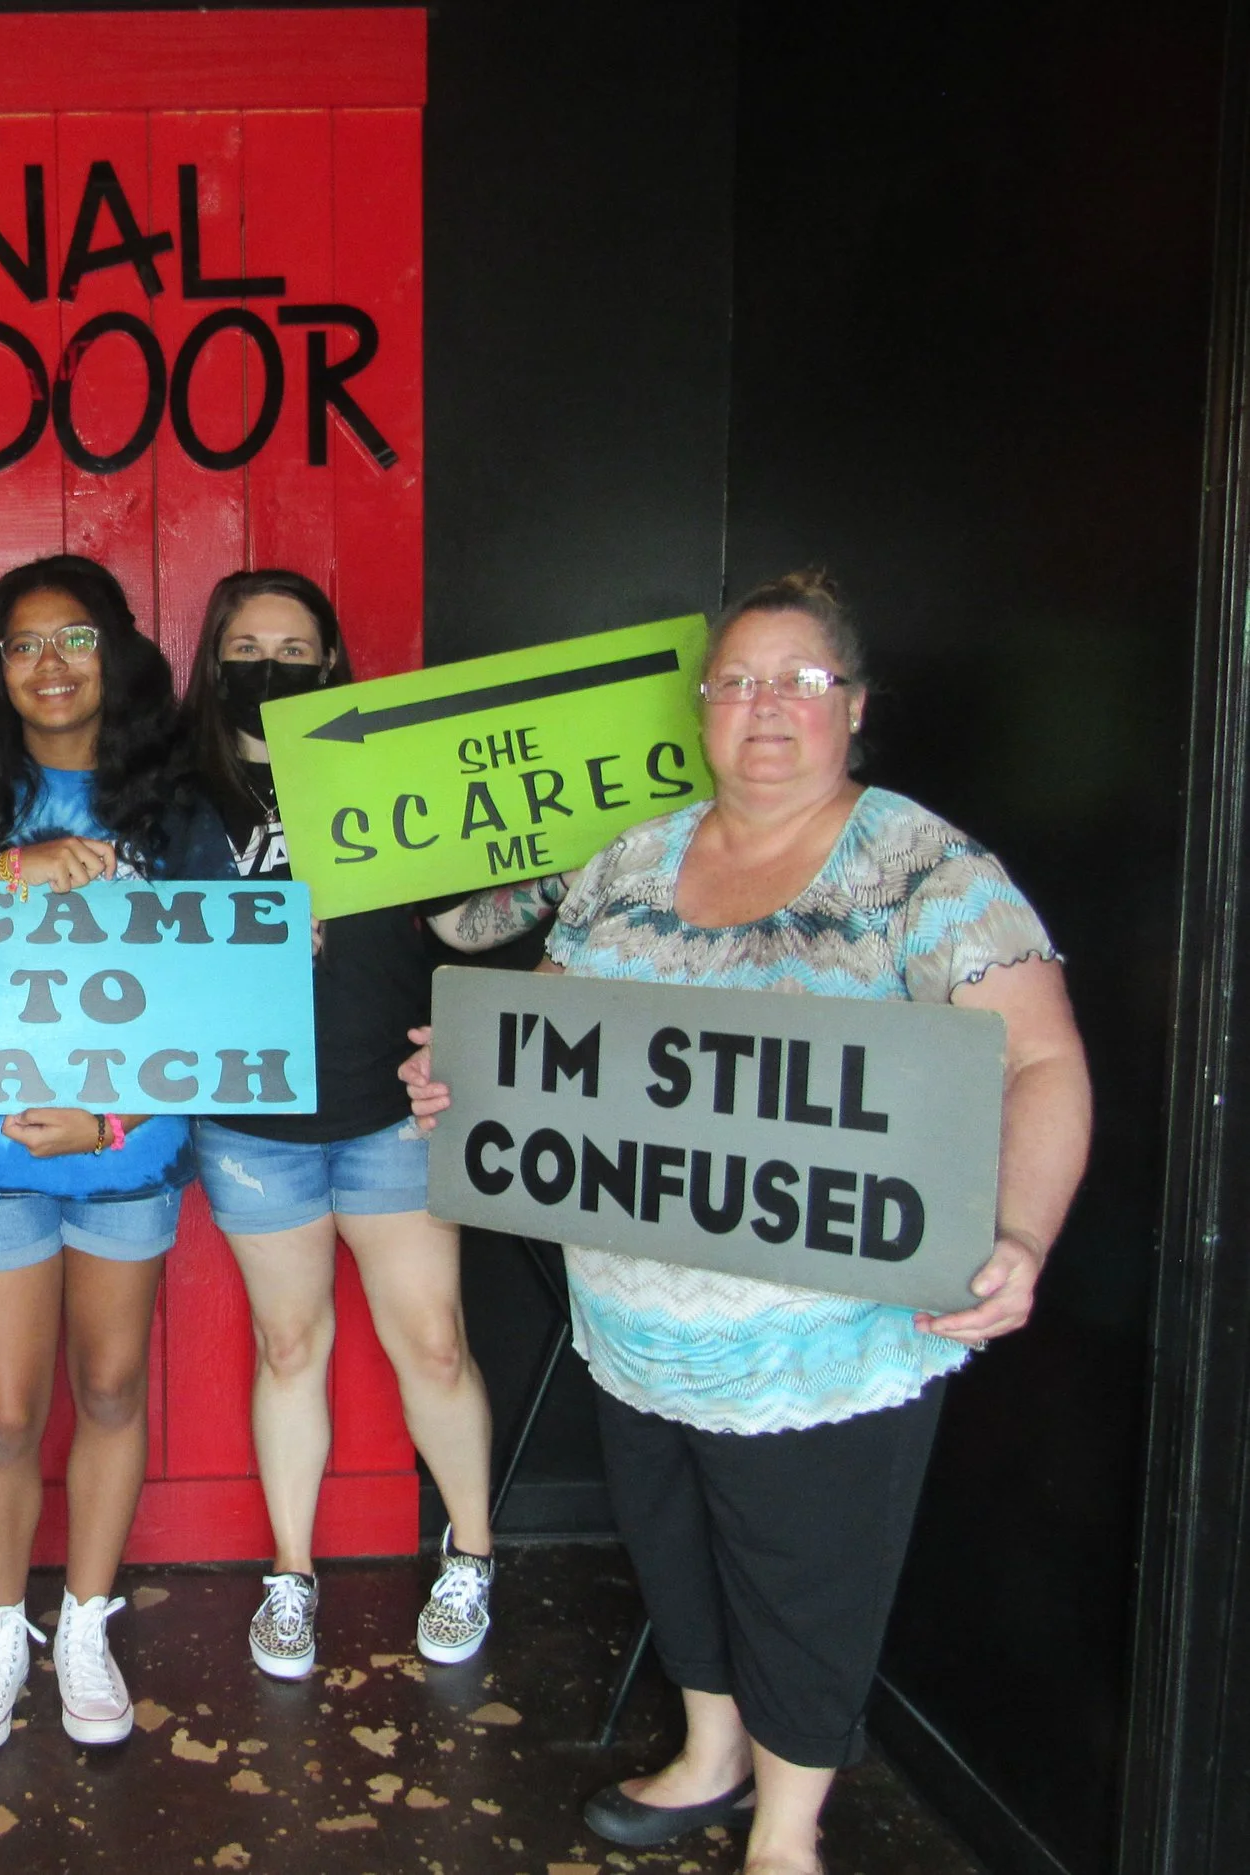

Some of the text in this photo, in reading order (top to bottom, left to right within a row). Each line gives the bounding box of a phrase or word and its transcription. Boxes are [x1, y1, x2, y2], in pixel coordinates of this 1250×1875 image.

[458, 727, 543, 775] SHE
[331, 742, 694, 864] SCARES
[226, 822, 289, 876] VA
[486, 832, 553, 875] ME
[10, 969, 147, 1024] TO
[498, 1012, 889, 1134] I'M STILL
[464, 1119, 925, 1263] CONFUSED
